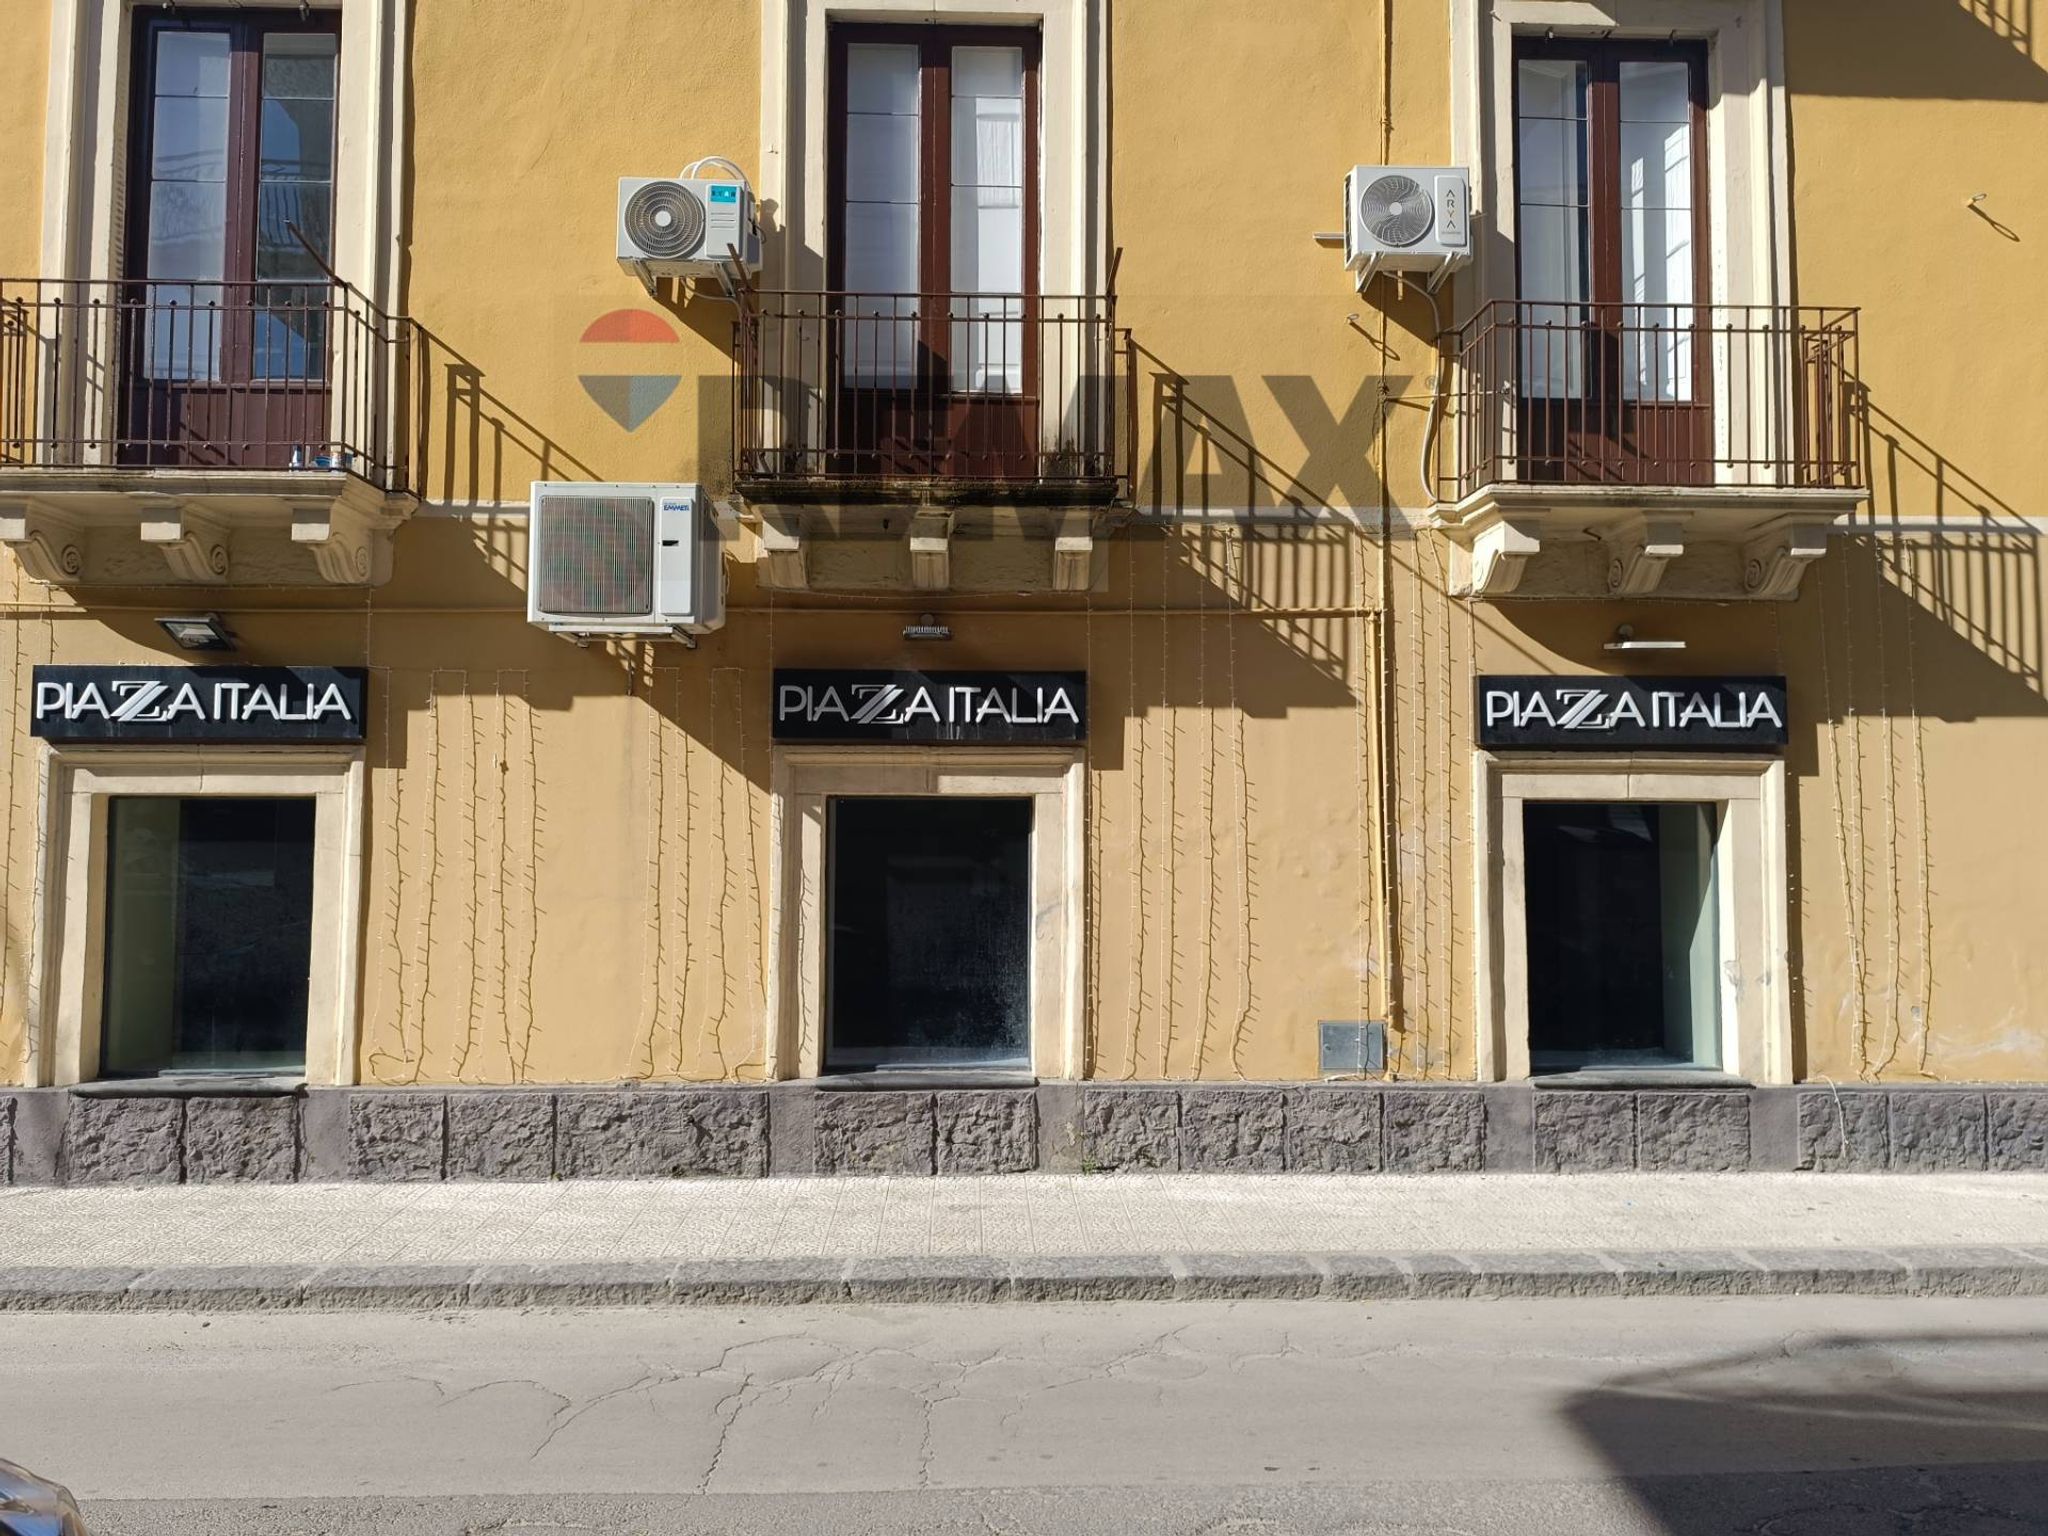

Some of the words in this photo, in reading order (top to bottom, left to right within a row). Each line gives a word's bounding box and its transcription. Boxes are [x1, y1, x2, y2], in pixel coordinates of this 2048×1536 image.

[36, 680, 206, 722] PIAZZA
[214, 682, 352, 720] ITALIA
[779, 684, 940, 724] PIAZZA
[949, 686, 1080, 724] ITALIA
[1486, 688, 1646, 729] PIAZZA
[1653, 691, 1783, 728] ITALIA
